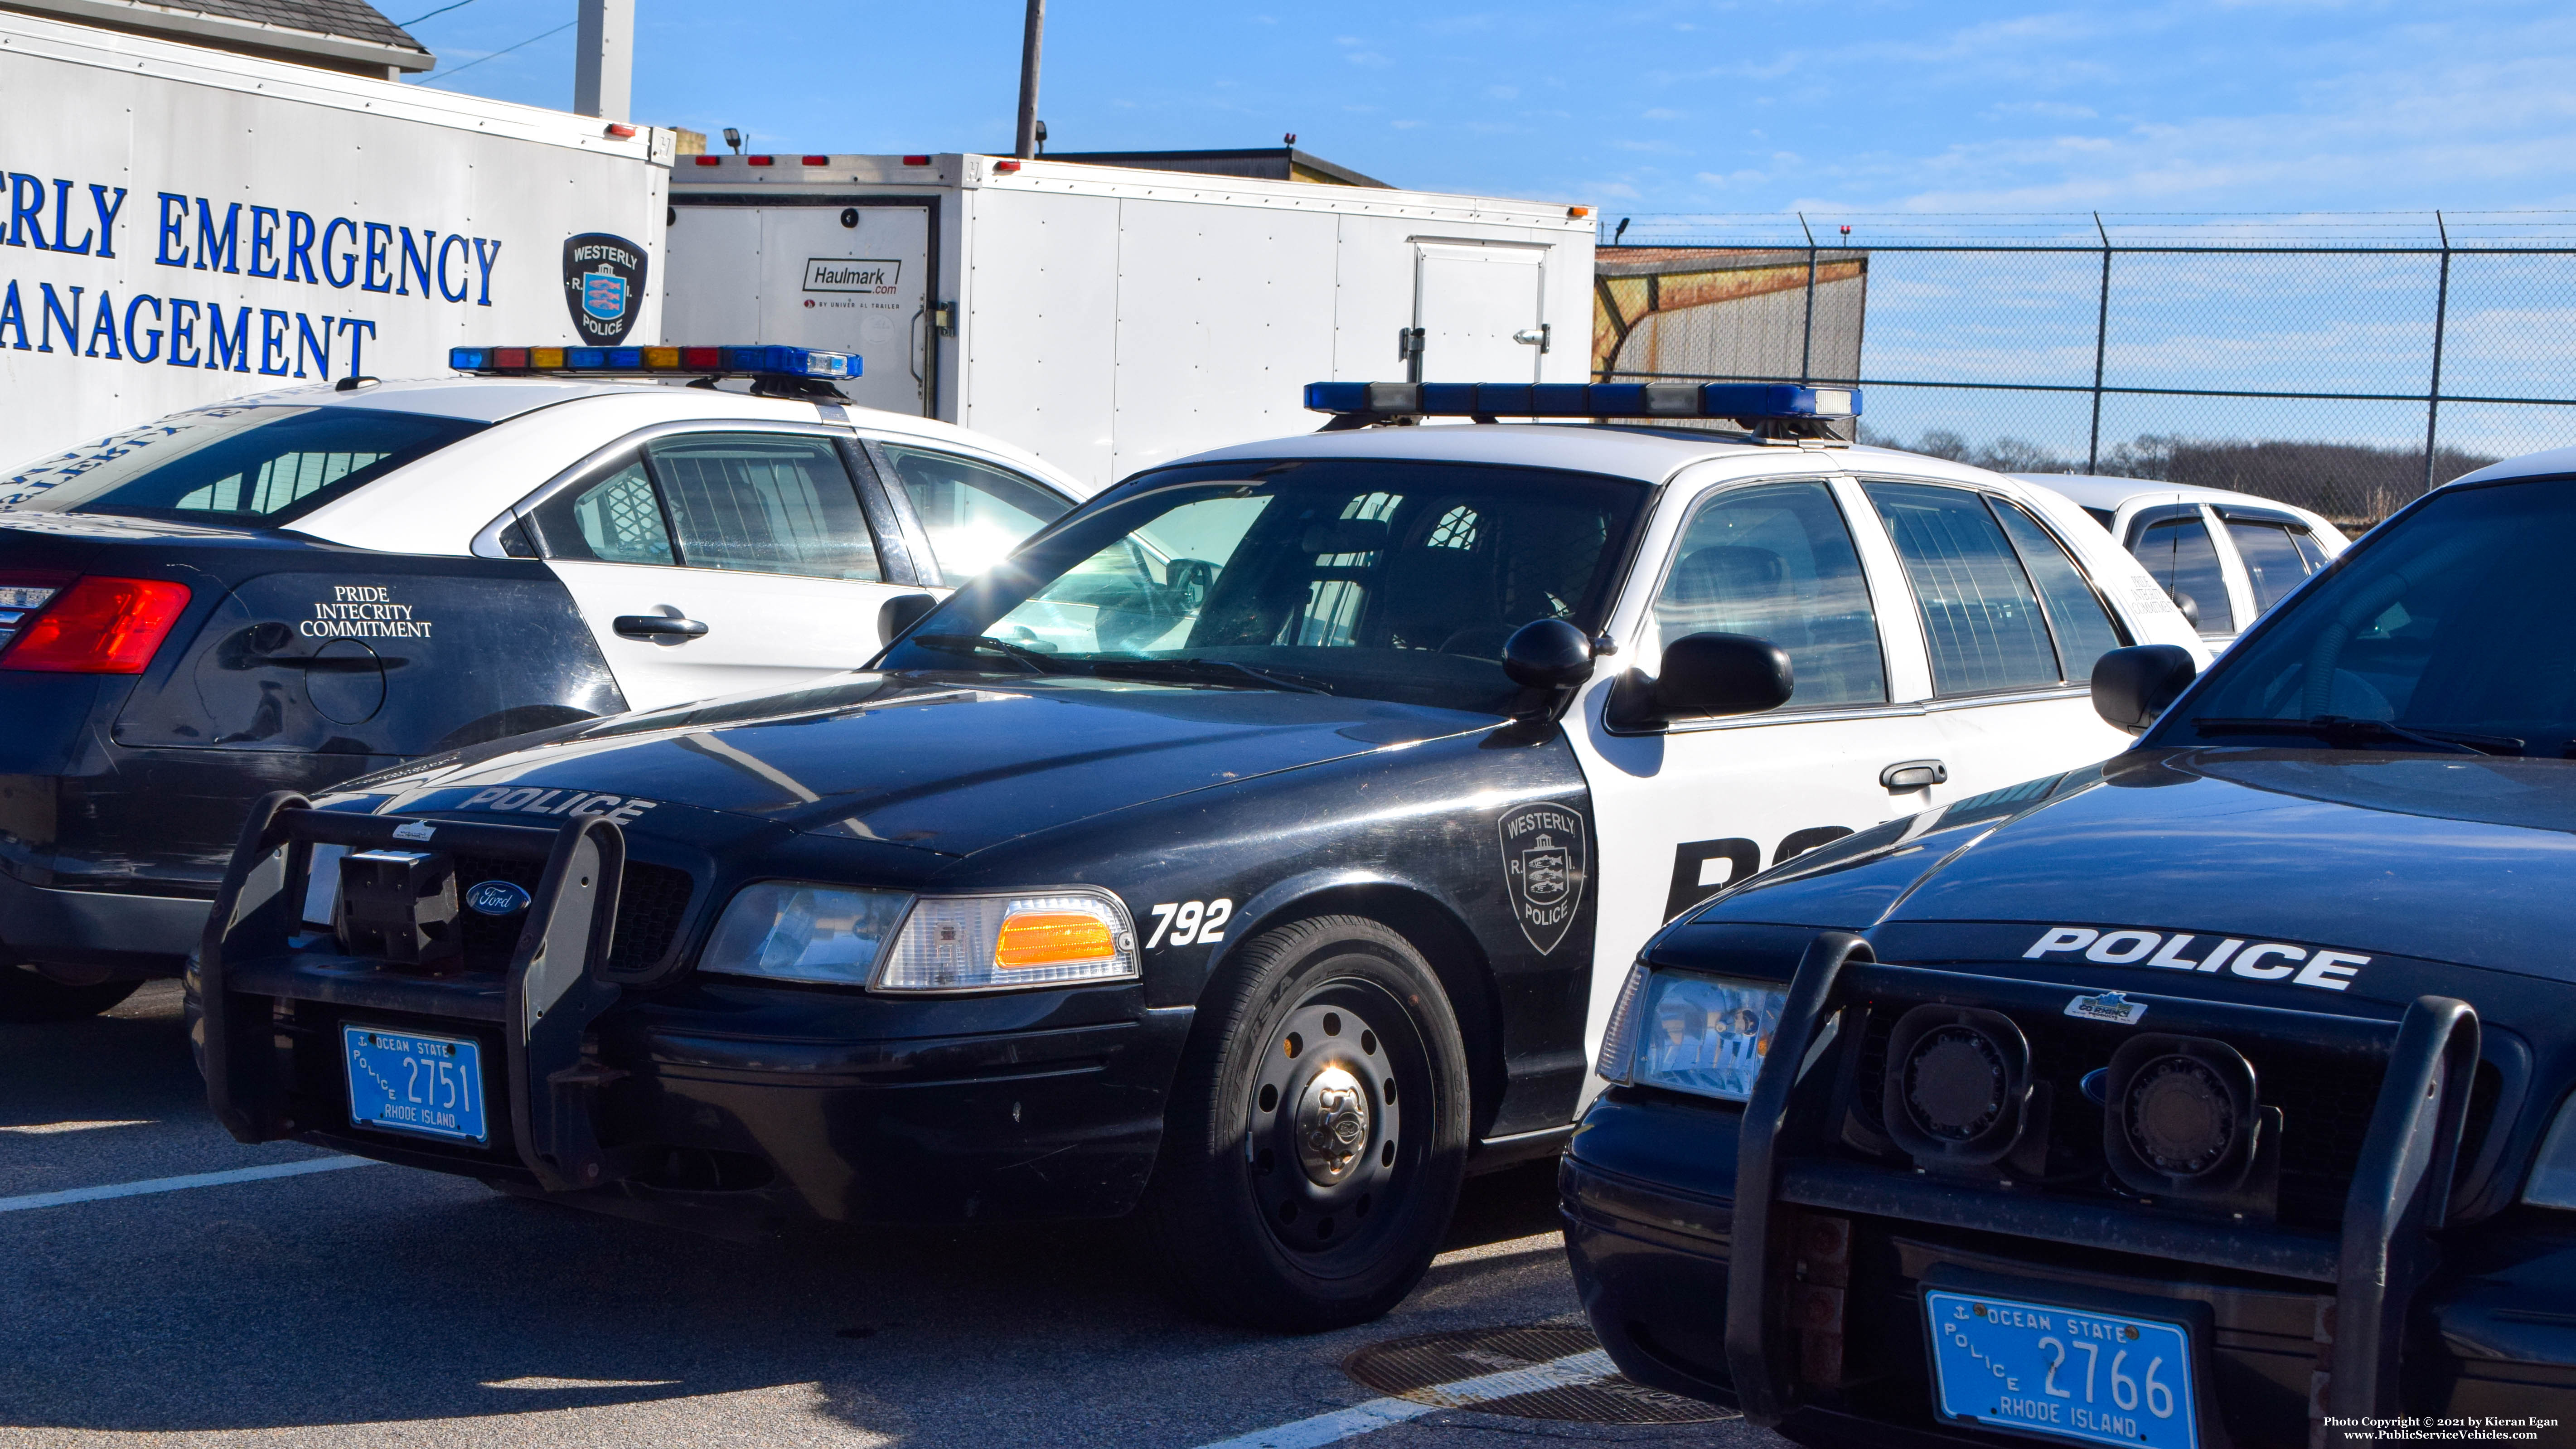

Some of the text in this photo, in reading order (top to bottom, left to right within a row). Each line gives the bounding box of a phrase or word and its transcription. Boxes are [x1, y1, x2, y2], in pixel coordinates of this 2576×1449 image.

[0, 171, 501, 306] RLY EMERGENCY
[575, 245, 637, 270] WESTERLY
[572, 277, 583, 290] R.
[815, 267, 885, 284] Haulmark
[872, 286, 896, 294] .com
[0, 279, 376, 381] ANAGEMENT
[583, 314, 623, 335] POLICE
[334, 586, 389, 602] PRIDE
[300, 620, 431, 637] COMMITMENT
[455, 788, 657, 825] POLICE
[1508, 812, 1574, 839] WESTERLY
[1511, 860, 1523, 874] R.
[479, 887, 513, 907] Ford
[1145, 898, 1232, 949] 792
[1525, 899, 1567, 926] POLICE
[2022, 927, 2372, 991] POLICE
[376, 1037, 449, 1058] OCEAN STATE
[353, 1050, 397, 1100] POLICE
[403, 1057, 470, 1112] 2751
[385, 1104, 455, 1128] RHODE ISLAND
[1987, 1309, 2126, 1344] OCEAN STATE
[1944, 1323, 2020, 1392] POLICE
[2038, 1337, 2174, 1419] 2766
[2000, 1396, 2136, 1439] RHODE ISLAND
